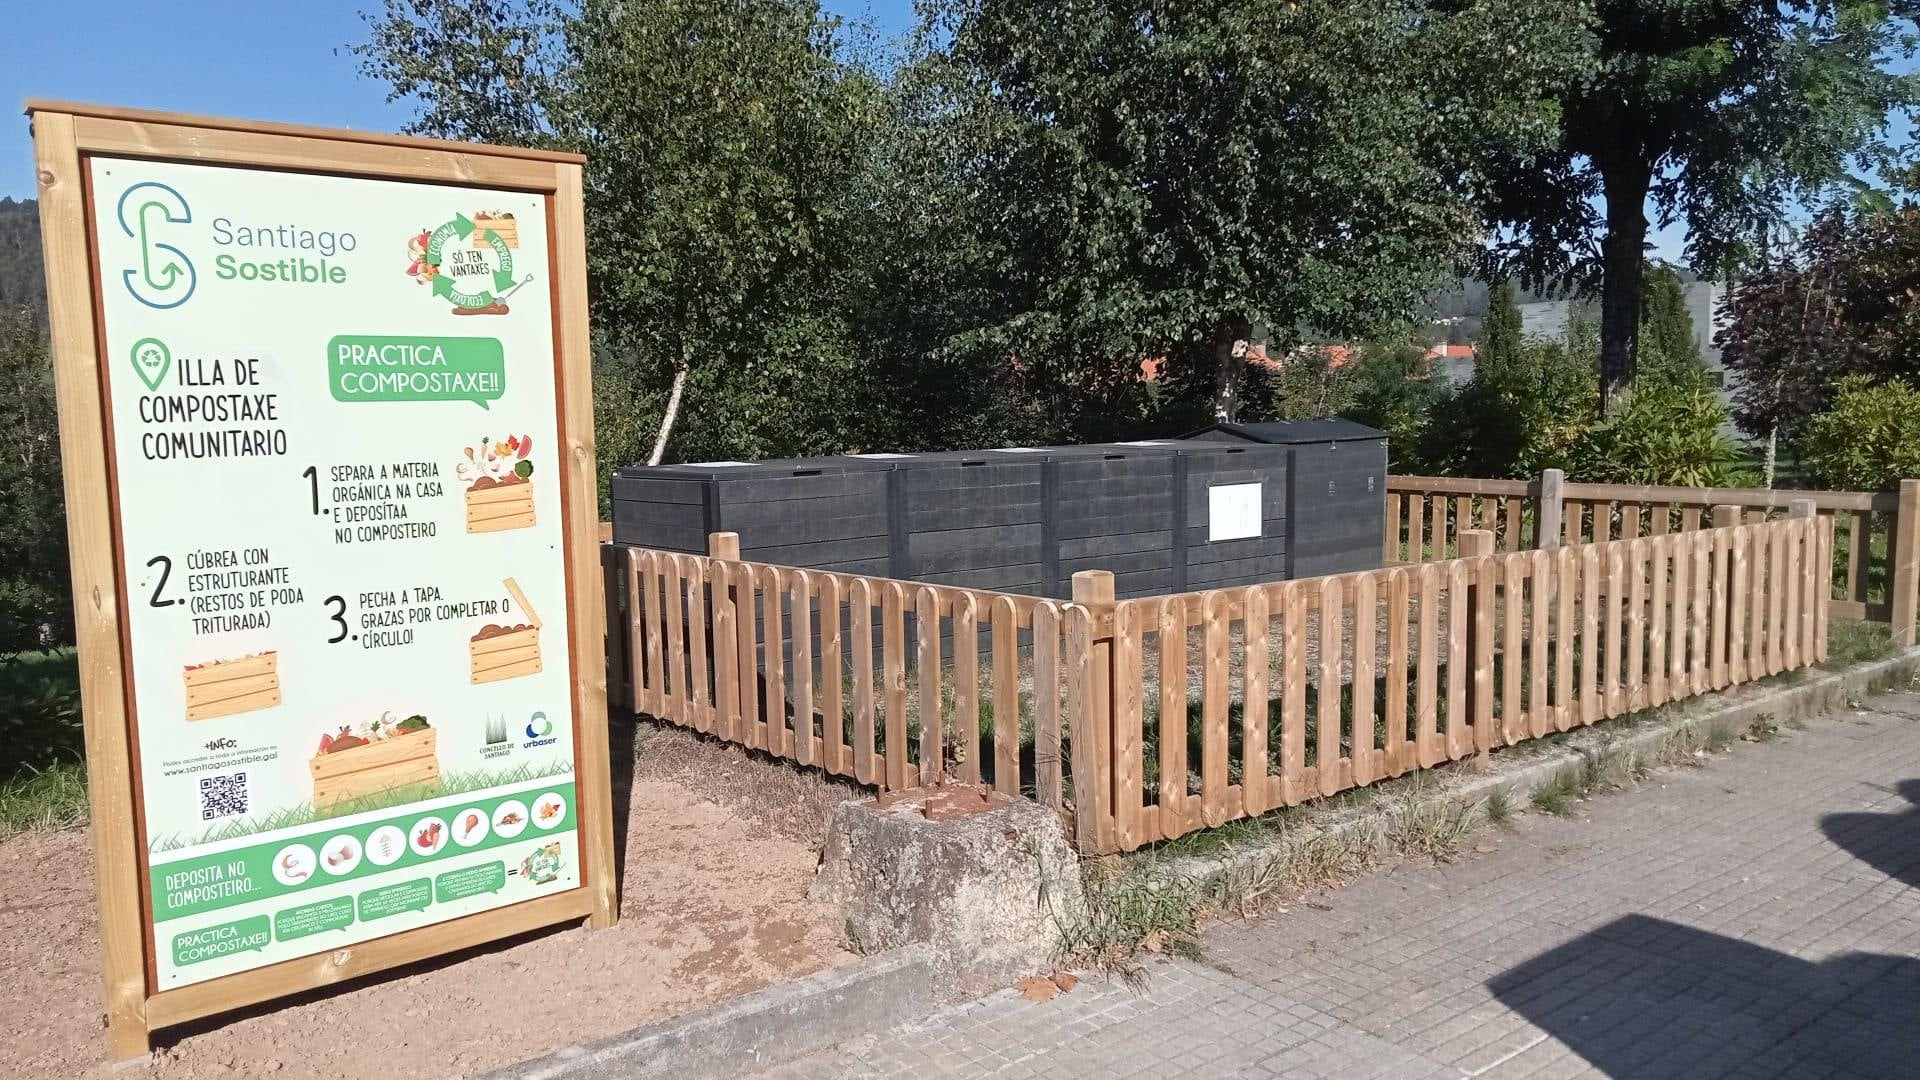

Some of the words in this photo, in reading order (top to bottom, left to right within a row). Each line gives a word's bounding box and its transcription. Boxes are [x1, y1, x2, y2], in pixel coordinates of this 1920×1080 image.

[212, 217, 356, 256] Santiago
[215, 254, 347, 284] Sostible
[466, 250, 483, 264] TEN
[450, 262, 490, 277] VANTAXES
[338, 344, 447, 366] PRACTICA
[178, 358, 225, 386] ILLA
[234, 358, 260, 386] DE
[340, 372, 499, 393] COMPOSTAXE!!
[139, 394, 278, 423] COMPOSTAXE
[142, 429, 287, 460] COMUNITARIO
[331, 465, 375, 482] SEPARA
[380, 464, 388, 480] A
[392, 462, 439, 479] MATERIA
[302, 465, 330, 515] 1.
[332, 482, 391, 503] ORGÁNICA
[396, 483, 411, 499] NA
[416, 482, 443, 498] CASA
[333, 508, 341, 523] E
[346, 501, 408, 523] DEPOSÍTAA
[335, 527, 352, 544] NO
[357, 522, 436, 542] COMPOSTEIRO
[187, 549, 238, 570] CÚBREA
[244, 548, 269, 565] CON
[146, 555, 186, 608] 2.
[188, 567, 289, 592] ESTRUTURANTE
[190, 592, 245, 615] (RESTOS
[250, 590, 266, 608] DE
[271, 587, 304, 606] PODA
[359, 591, 396, 609] PECHA
[401, 590, 409, 605] A
[414, 586, 444, 603] TAPA.
[192, 610, 271, 635] TRITURADA)
[323, 595, 358, 644] 3.
[361, 610, 405, 629] GRAZAS
[409, 607, 432, 624] POR
[436, 600, 498, 620] COMPLETAR
[502, 598, 510, 613] O
[362, 628, 414, 649] CÍRCULO!
[523, 737, 557, 749] urbaser
[164, 752, 278, 776] www.santiagosostible.gal
[165, 865, 224, 892] DEPOSITA
[228, 860, 246, 879] NO
[177, 926, 238, 949] PRACTICA
